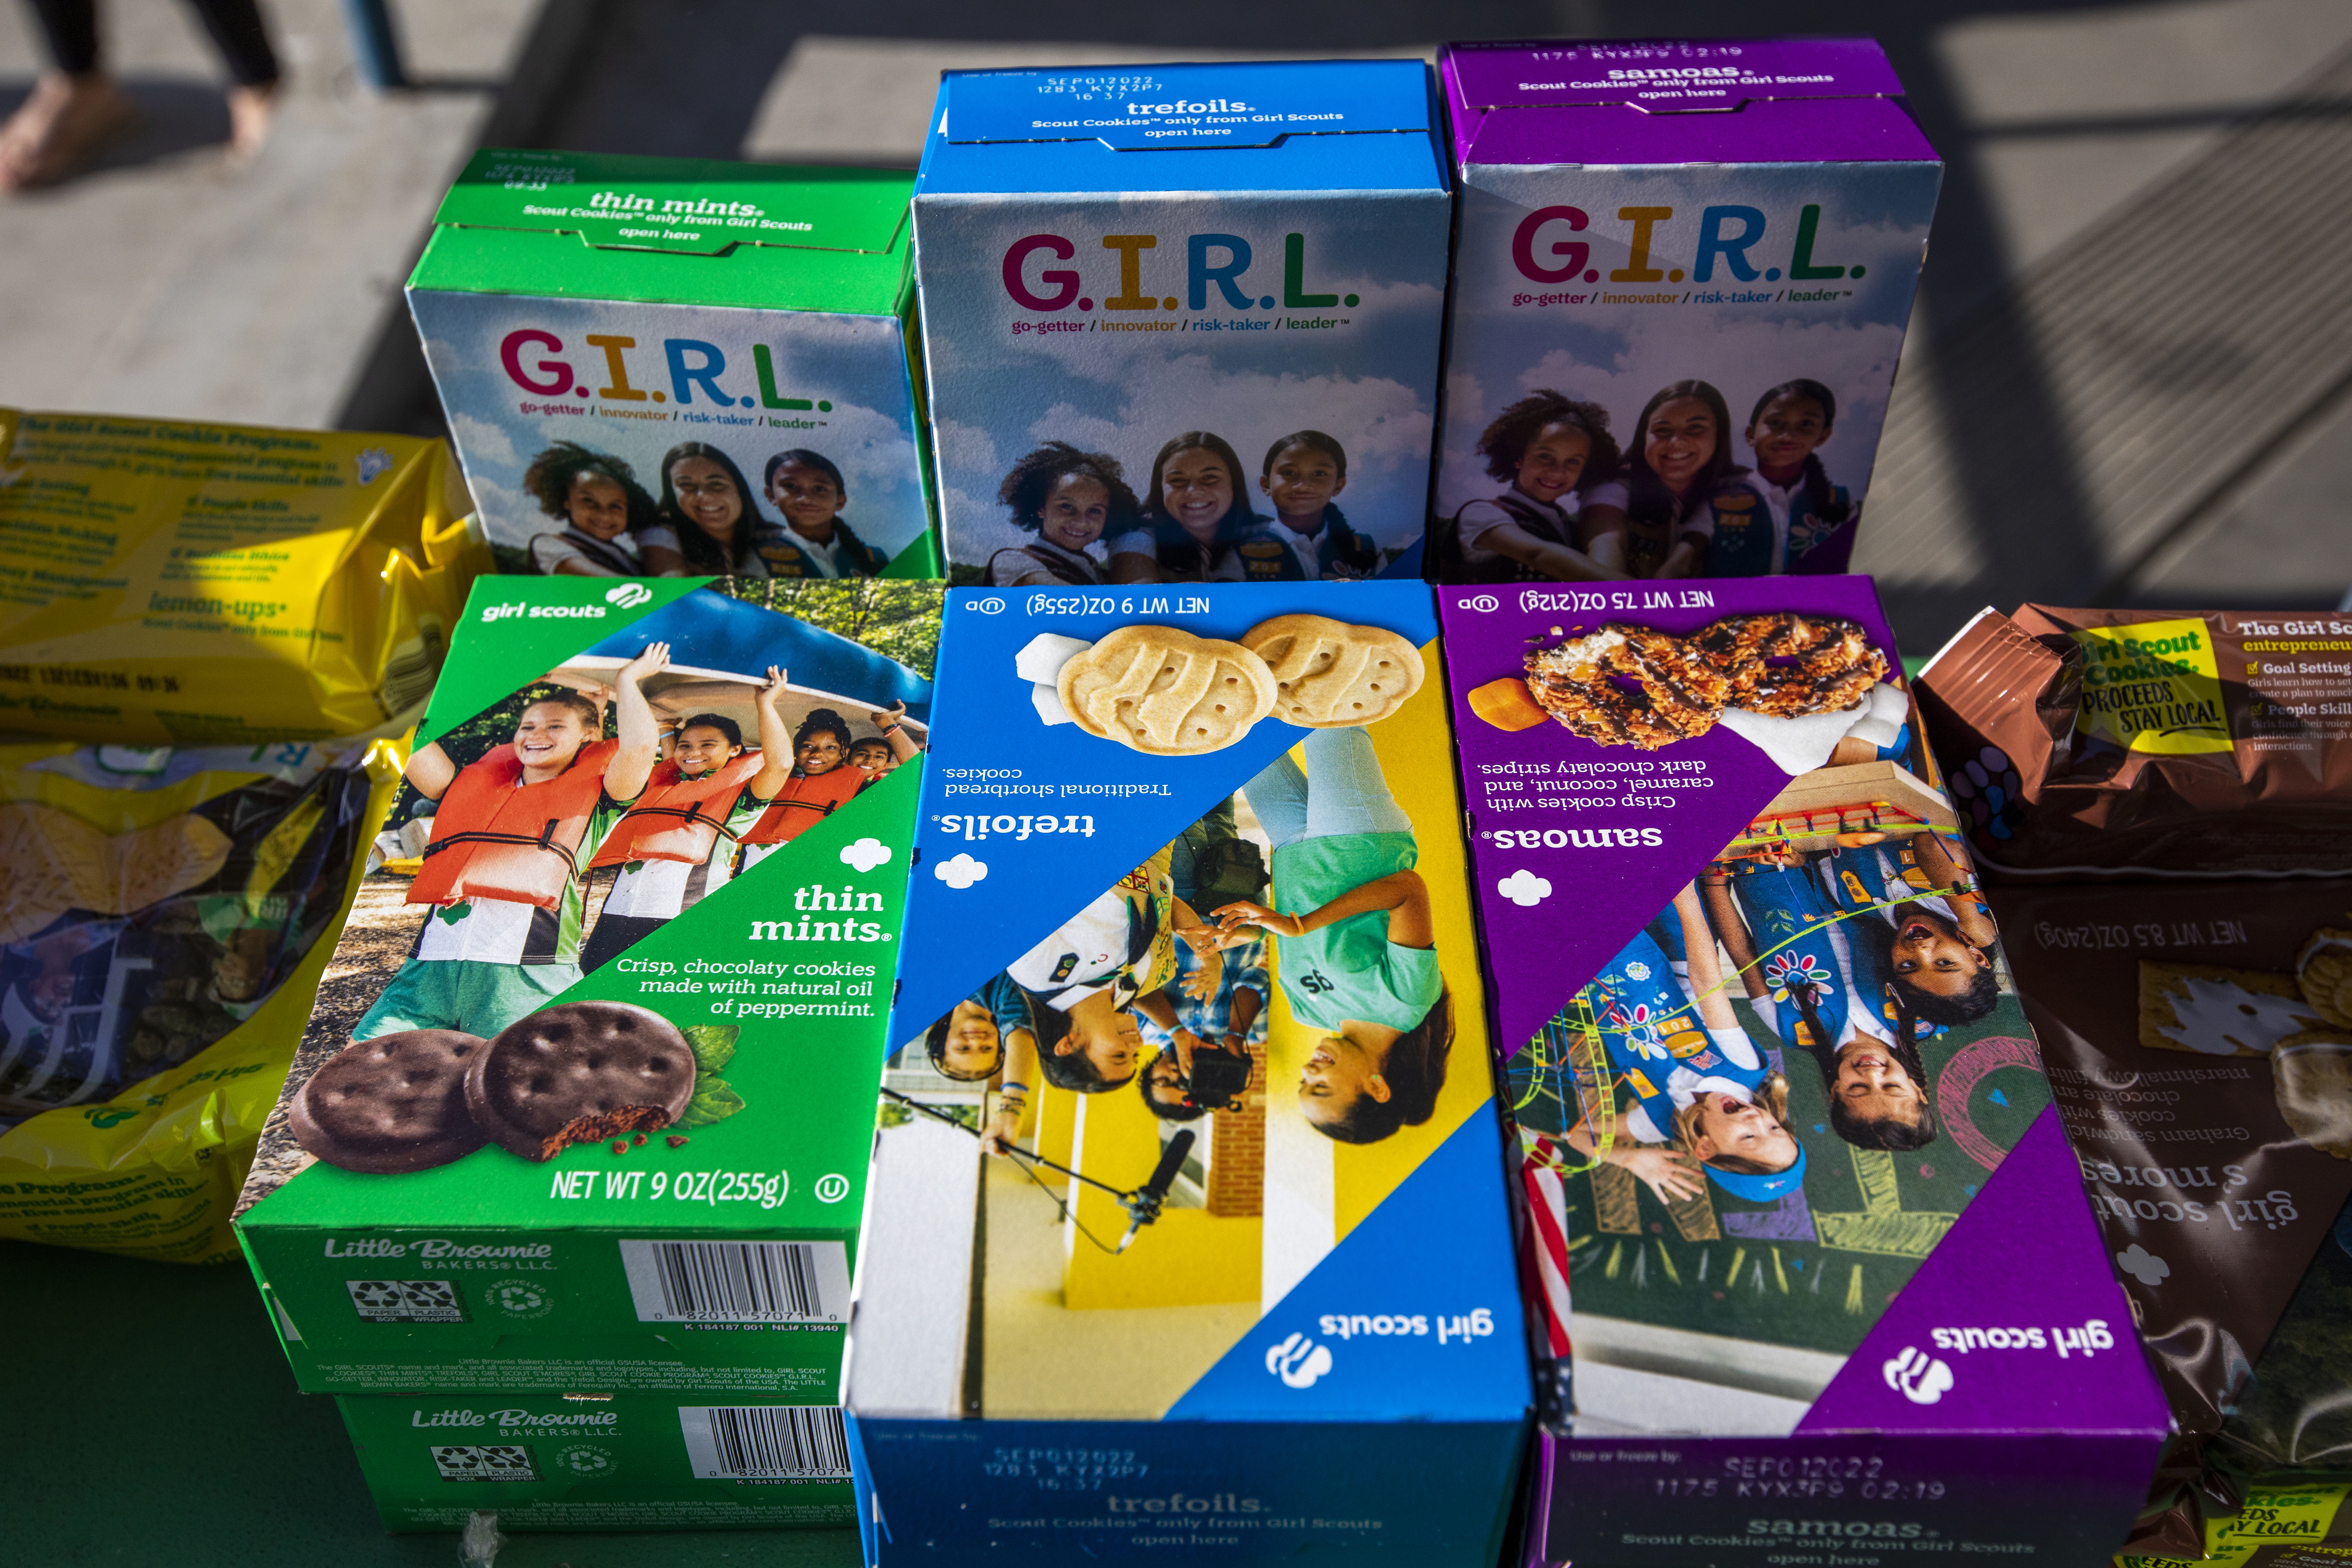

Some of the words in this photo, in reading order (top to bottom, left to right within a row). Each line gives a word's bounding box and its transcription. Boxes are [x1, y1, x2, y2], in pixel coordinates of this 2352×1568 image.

[1048, 76, 1154, 86] SEP012022
[1091, 83, 1163, 92] KYX2P7
[1518, 82, 1567, 91] Scout
[1652, 78, 1689, 88] only
[1693, 77, 1738, 86] from
[1739, 75, 1774, 85] Girl
[1775, 73, 1835, 83] Scouts
[1638, 91, 1683, 99] open
[1685, 88, 1726, 97] here
[1031, 119, 1079, 128] Scout
[1165, 116, 1203, 126] only
[1206, 115, 1247, 124] from
[1252, 113, 1285, 122] Girl
[1288, 112, 1344, 122] Scouts
[1145, 129, 1187, 138] open
[1192, 127, 1232, 136] here
[590, 191, 654, 212] thin
[523, 205, 569, 217] Scout
[646, 213, 681, 226] only
[683, 213, 723, 226] from
[726, 217, 757, 228] Girl
[759, 219, 813, 232] Scouts
[619, 228, 659, 238] open
[662, 229, 701, 240] here
[1512, 204, 1866, 283] G.I.R.L.
[1002, 233, 1359, 312] G.I.R.L.
[1512, 292, 1586, 307] go-getter
[1603, 291, 1679, 305] innovator
[1694, 290, 1772, 305] risk-taker
[1012, 320, 1084, 335] go-getter
[1101, 319, 1176, 332] innovator
[1192, 318, 1270, 332] risk-taker
[500, 328, 833, 413] G.I.R.L.
[520, 399, 586, 417] go-getter
[599, 404, 668, 422] innovator
[683, 410, 754, 427] risk-taker
[1121, 597, 1133, 614] 9
[1140, 597, 1169, 614] WT
[1175, 597, 1210, 614] NET
[1612, 591, 1638, 610] 7.5
[1643, 591, 1674, 609] WT
[1680, 590, 1715, 608] NET
[482, 601, 526, 622] girl
[529, 604, 606, 619] scouts
[2239, 621, 2280, 636] The
[2284, 620, 2326, 636] Girl
[2082, 638, 2120, 664] irl
[2124, 630, 2201, 658] Scout
[2263, 662, 2296, 674] Goal
[2298, 661, 2352, 676] Setting
[2248, 678, 2272, 687] Girls
[2274, 677, 2299, 687] learn
[2301, 677, 2323, 686] how
[2326, 677, 2335, 686] to
[2082, 680, 2174, 715] PROCEEDS
[2291, 688, 2313, 700] plan
[2316, 688, 2325, 697] to
[2120, 707, 2163, 733] STAY
[2167, 699, 2221, 726] LOCAL
[2269, 702, 2317, 718] People
[942, 768, 1022, 781] cookies.
[1477, 761, 1551, 776] stripes.
[1557, 760, 1654, 775] chocolaty
[1659, 760, 1706, 774] dark
[945, 784, 1054, 798] shortbread
[1061, 784, 1172, 797] Traditional
[1484, 781, 1524, 794] and
[1531, 779, 1618, 792] coconut,
[1623, 777, 1714, 792] caramel,
[1486, 798, 1534, 812] with
[1538, 797, 1616, 811] cookies
[1621, 794, 1676, 809] Crisp
[793, 884, 884, 912] thin
[2171, 922, 2205, 947] WT
[2209, 921, 2247, 945] NET
[616, 958, 678, 977] Crisp,
[683, 958, 790, 979] chocolaty
[793, 961, 876, 977] cookies
[638, 978, 703, 995] made
[706, 979, 759, 995] with
[762, 980, 841, 997] natural
[845, 981, 873, 997] oil
[710, 999, 736, 1015] of
[738, 1001, 876, 1018] peppermint.
[1659, 1018, 1690, 1034] 201
[2084, 1088, 2180, 1105] chocolate
[2098, 1108, 2176, 1126] cookies
[2160, 1126, 2250, 1144] Graham
[550, 1171, 600, 1199] NET
[605, 1171, 646, 1200] WT
[649, 1172, 668, 1200] 9
[2092, 1193, 2209, 1223] scout
[2217, 1190, 2298, 1231] girl
[324, 1238, 406, 1258] Little
[408, 1238, 553, 1258] Brownie
[516, 1261, 558, 1270] L.L.C.
[686, 1310, 741, 1321] 82011
[750, 1311, 806, 1321] 57071
[1318, 1314, 1429, 1340] scouts
[1436, 1307, 1494, 1345] girl
[1930, 1326, 2047, 1354] scouts
[2050, 1318, 2114, 1359] girl
[412, 1409, 485, 1427] Little
[488, 1409, 617, 1427] Brownie
[739, 1469, 788, 1477] 82011
[797, 1468, 846, 1476] 57071
[2254, 1519, 2321, 1535] LOCAL
